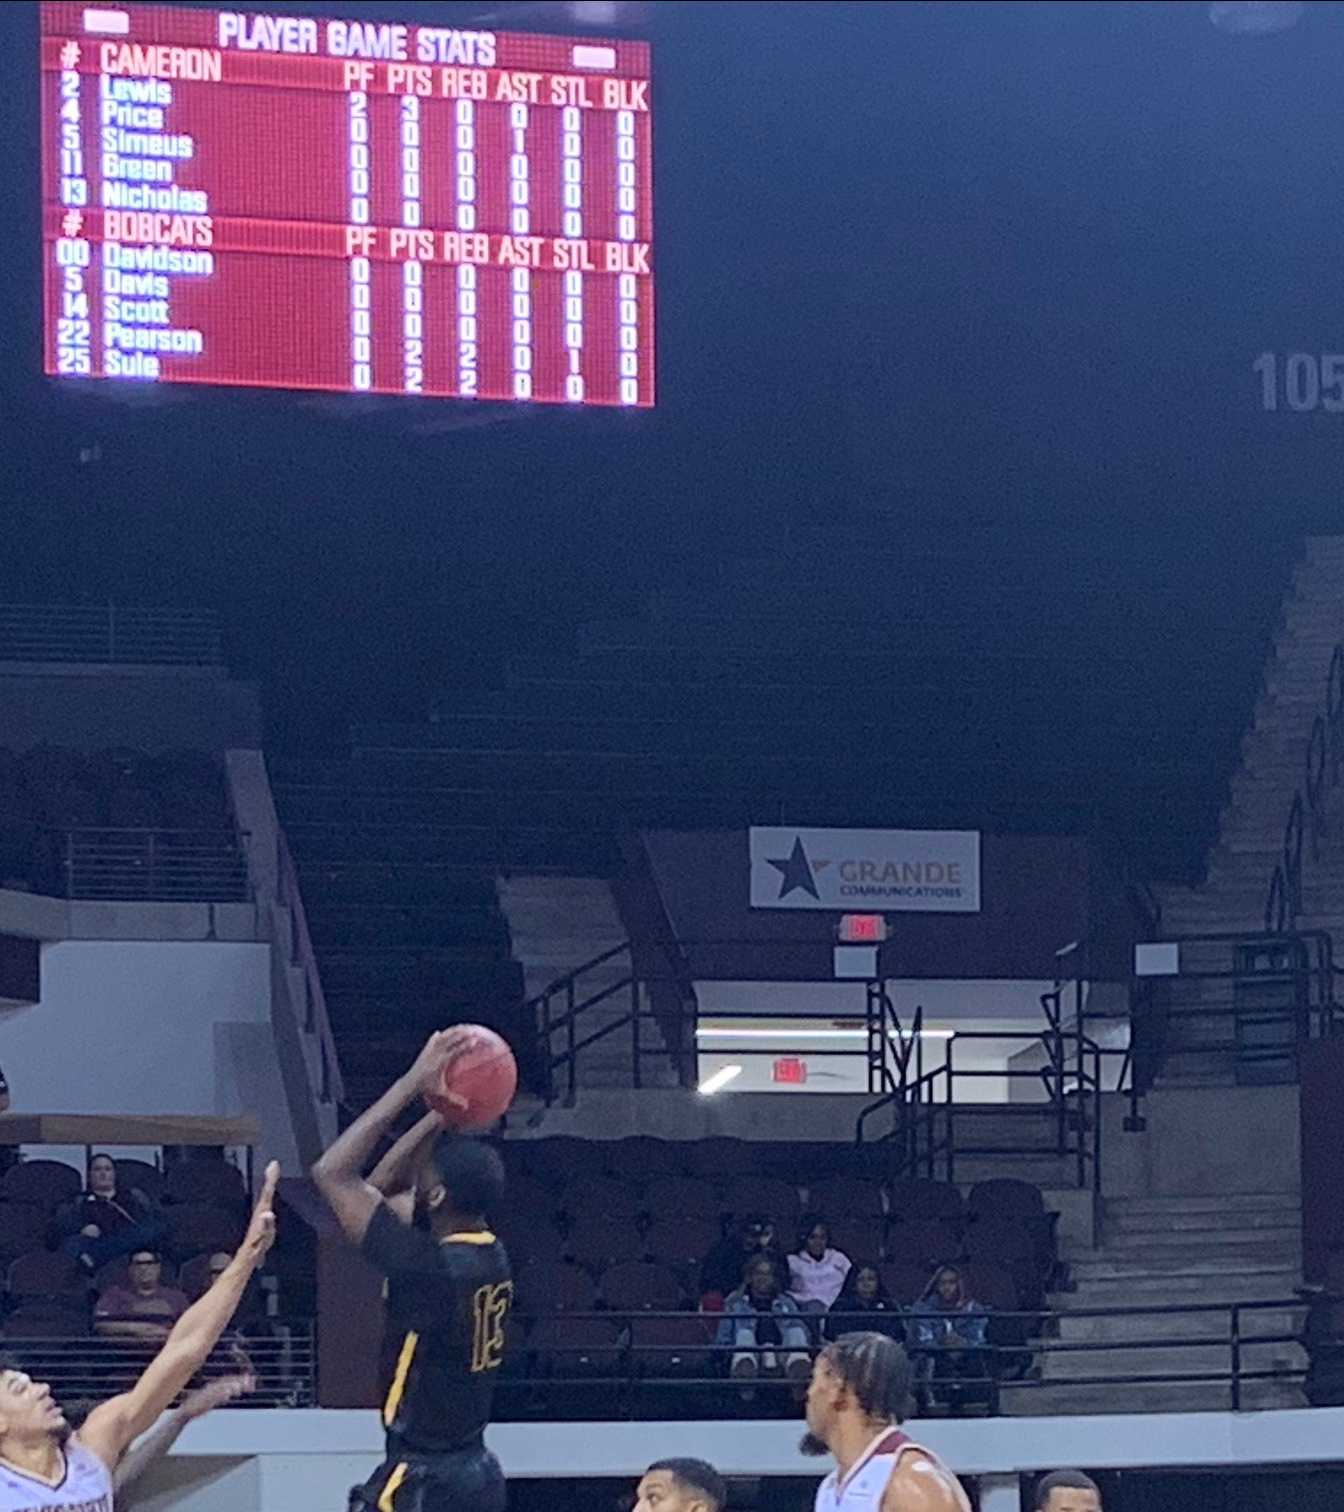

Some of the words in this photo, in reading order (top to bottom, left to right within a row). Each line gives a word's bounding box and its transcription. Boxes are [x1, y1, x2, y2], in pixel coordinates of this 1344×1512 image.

[218, 12, 317, 54] PLAYER
[327, 20, 407, 60] GAME
[417, 27, 496, 66] STATS
[60, 40, 81, 70] #
[100, 42, 223, 82] CAMERON
[344, 62, 374, 90] PF
[388, 65, 432, 97] PTS
[442, 69, 487, 98] REB
[496, 75, 542, 103] AST
[551, 79, 593, 106] STL
[604, 79, 649, 111] BLK
[61, 70, 80, 98] 2
[100, 73, 172, 104] Lewis
[350, 92, 367, 118] 2
[402, 95, 419, 121] 3
[61, 98, 81, 123] 4
[101, 99, 164, 129] Price
[515, 128, 524, 153] 1
[61, 124, 81, 150] 5
[102, 126, 193, 159] Simeus
[62, 150, 83, 176] 11
[102, 152, 172, 181] Green
[62, 177, 87, 205] 13
[102, 180, 208, 213] Nicholas
[56, 238, 90, 267] 00
[103, 241, 213, 274] Davidson
[62, 208, 84, 238] #
[104, 210, 213, 246] BOBCATS
[346, 226, 376, 255] PF
[390, 229, 434, 261] PTS
[444, 233, 489, 262] REB
[498, 235, 544, 266] AST
[553, 239, 594, 269] STL
[607, 242, 650, 273] BLK
[64, 267, 83, 292] 5
[104, 268, 169, 298] Davis
[63, 293, 88, 318] 14
[104, 295, 170, 324] Scott
[58, 319, 91, 346] 22
[104, 321, 202, 353] Pearson
[405, 340, 422, 365] 2
[460, 343, 477, 368] 2
[570, 350, 579, 373] 1
[58, 346, 91, 374] 25
[104, 348, 160, 377] Sule
[405, 366, 422, 393] 2
[460, 369, 477, 395] 2
[840, 860, 962, 884] GRANDE
